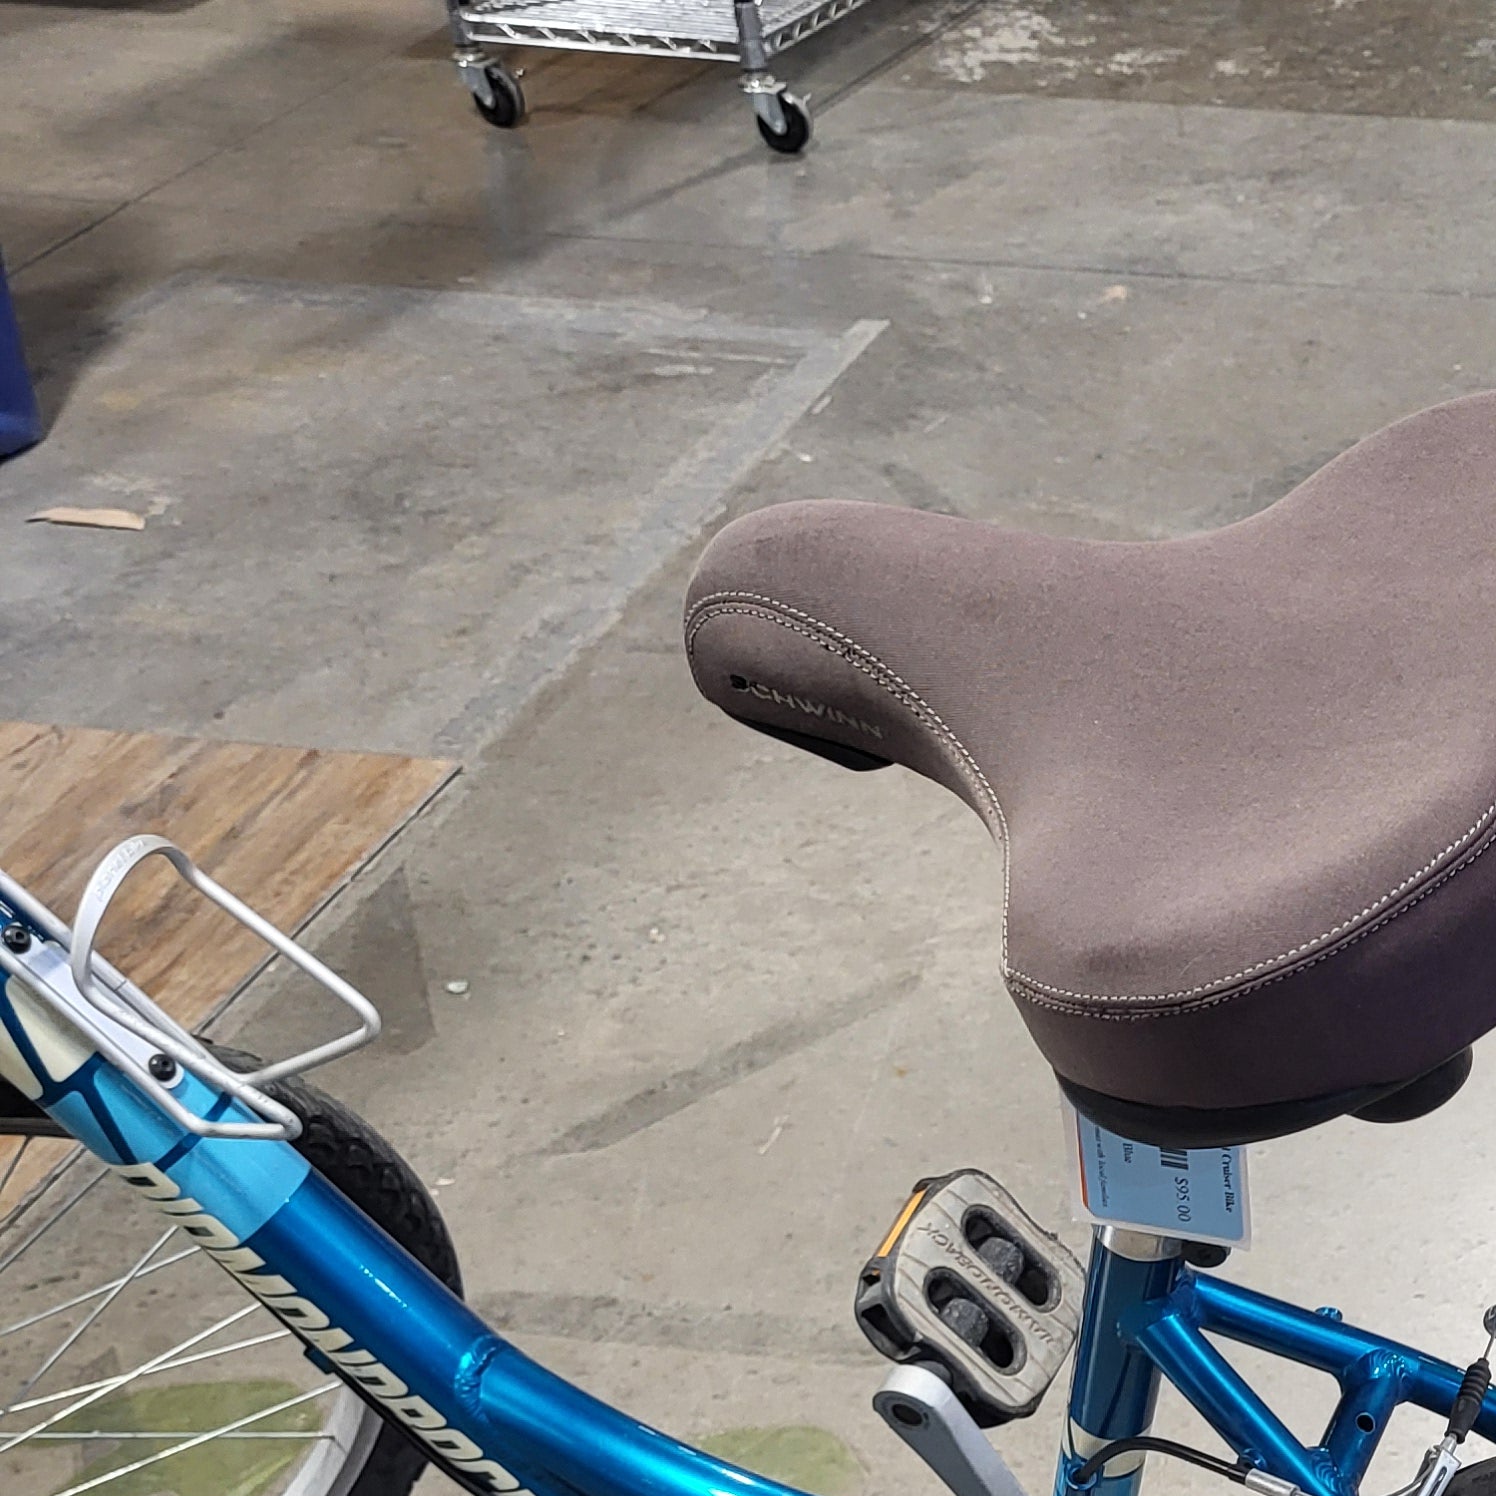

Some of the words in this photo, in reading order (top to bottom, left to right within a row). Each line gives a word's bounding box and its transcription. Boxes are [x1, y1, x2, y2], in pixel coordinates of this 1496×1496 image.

[1123, 1143, 1132, 1163] Blue
[1221, 1153, 1232, 1190] Cruiser
[1174, 1176, 1191, 1222] $95.00
[1224, 1191, 1234, 1213] Bike
